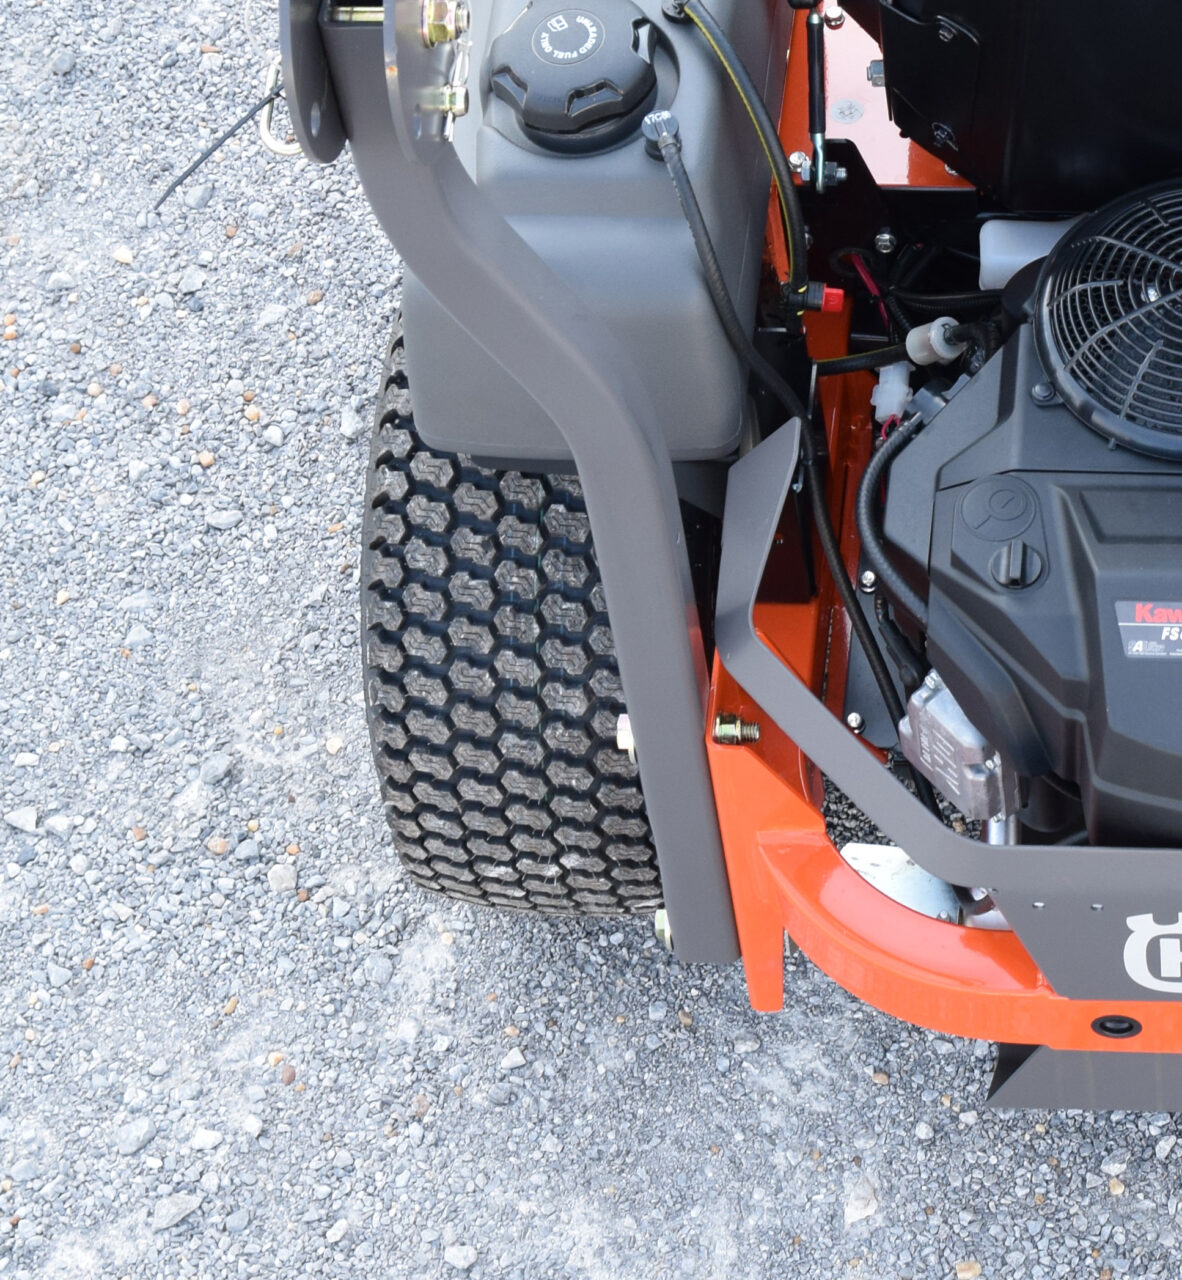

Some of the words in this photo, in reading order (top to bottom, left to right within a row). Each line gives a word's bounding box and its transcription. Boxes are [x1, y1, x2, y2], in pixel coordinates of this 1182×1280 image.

[540, 31, 553, 53] ONLY
[575, 15, 598, 54] UNLEADED
[552, 49, 579, 60] FUEL
